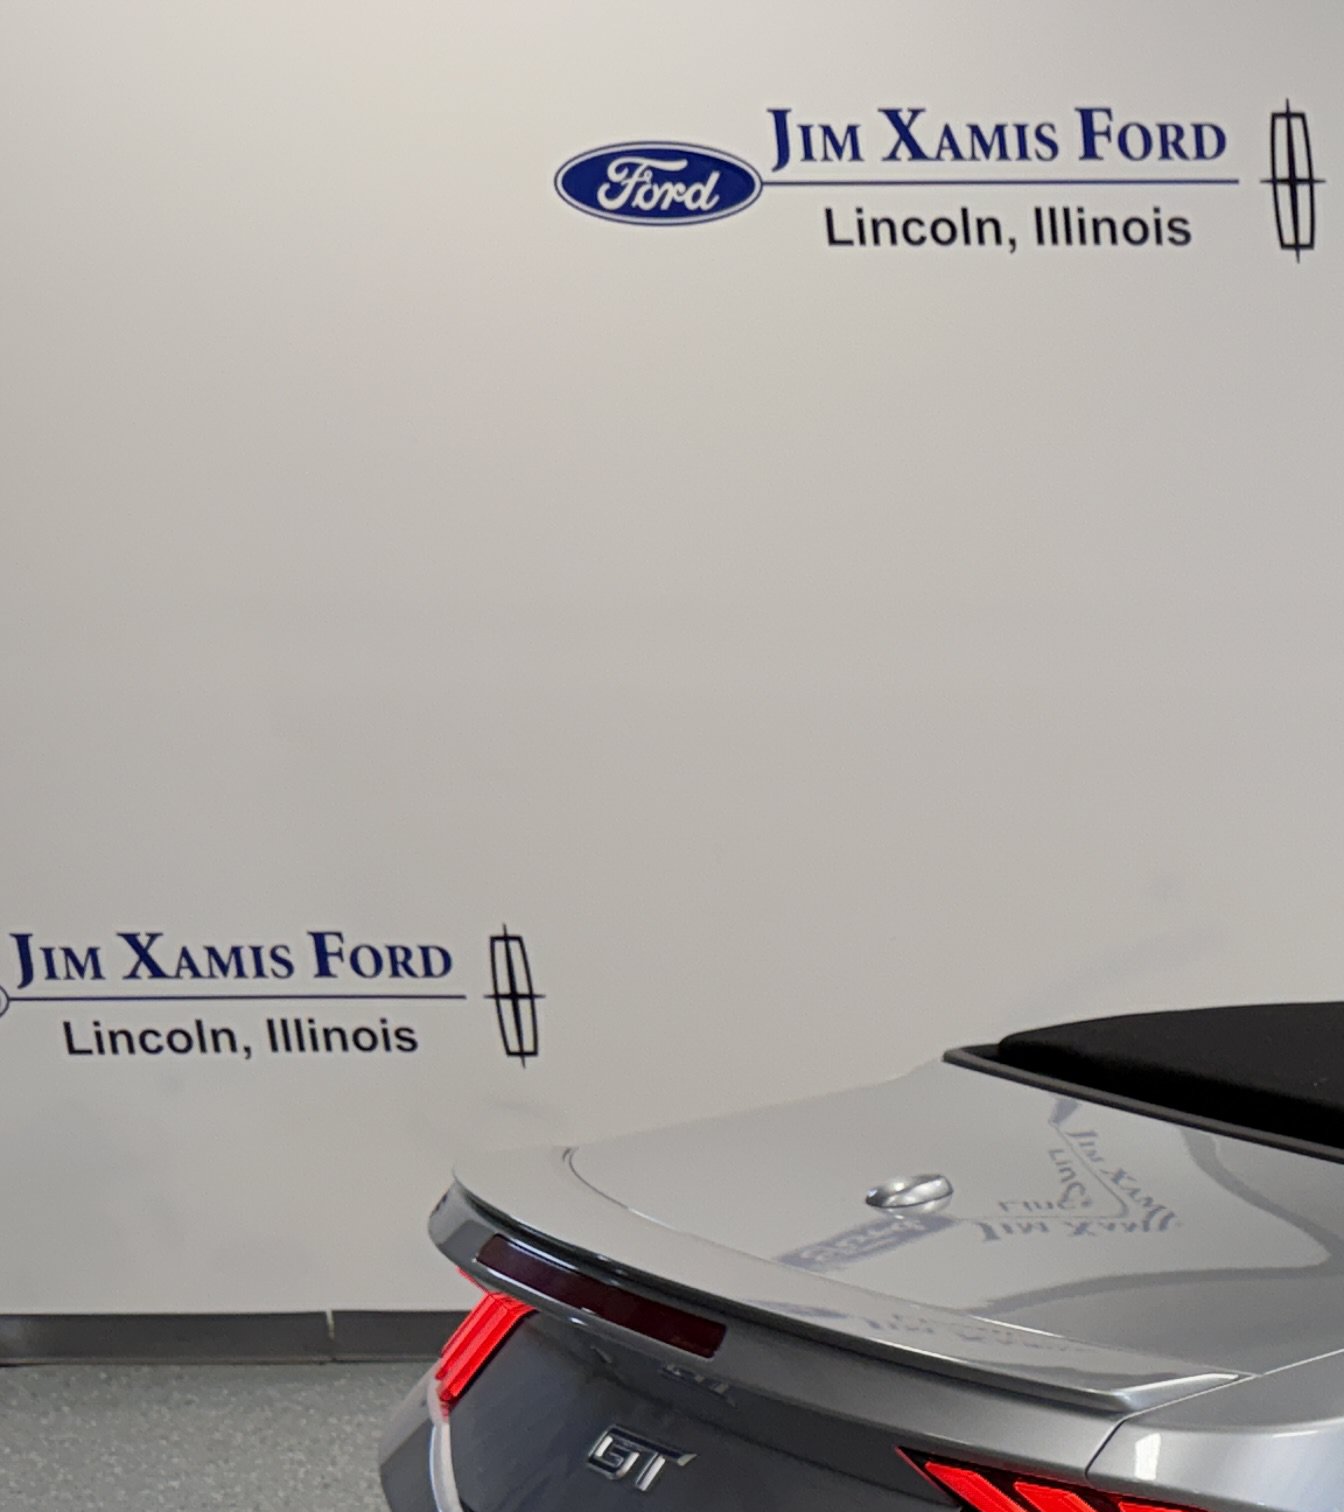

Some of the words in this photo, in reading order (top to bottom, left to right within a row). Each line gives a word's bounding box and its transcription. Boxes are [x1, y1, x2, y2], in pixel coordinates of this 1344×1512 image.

[767, 108, 865, 173] JIM
[877, 108, 1060, 162] XAMIS
[1074, 107, 1228, 162] FORD
[596, 155, 721, 212] Ford
[824, 206, 1018, 254] Lincoln,
[1033, 206, 1193, 247] Illinois
[9, 932, 107, 989] JIM
[116, 932, 296, 980] XAMIS
[307, 931, 454, 980] FORD
[62, 1019, 253, 1060] Lincoln,
[265, 1017, 420, 1053] Illinois
[586, 1424, 698, 1492] GT
